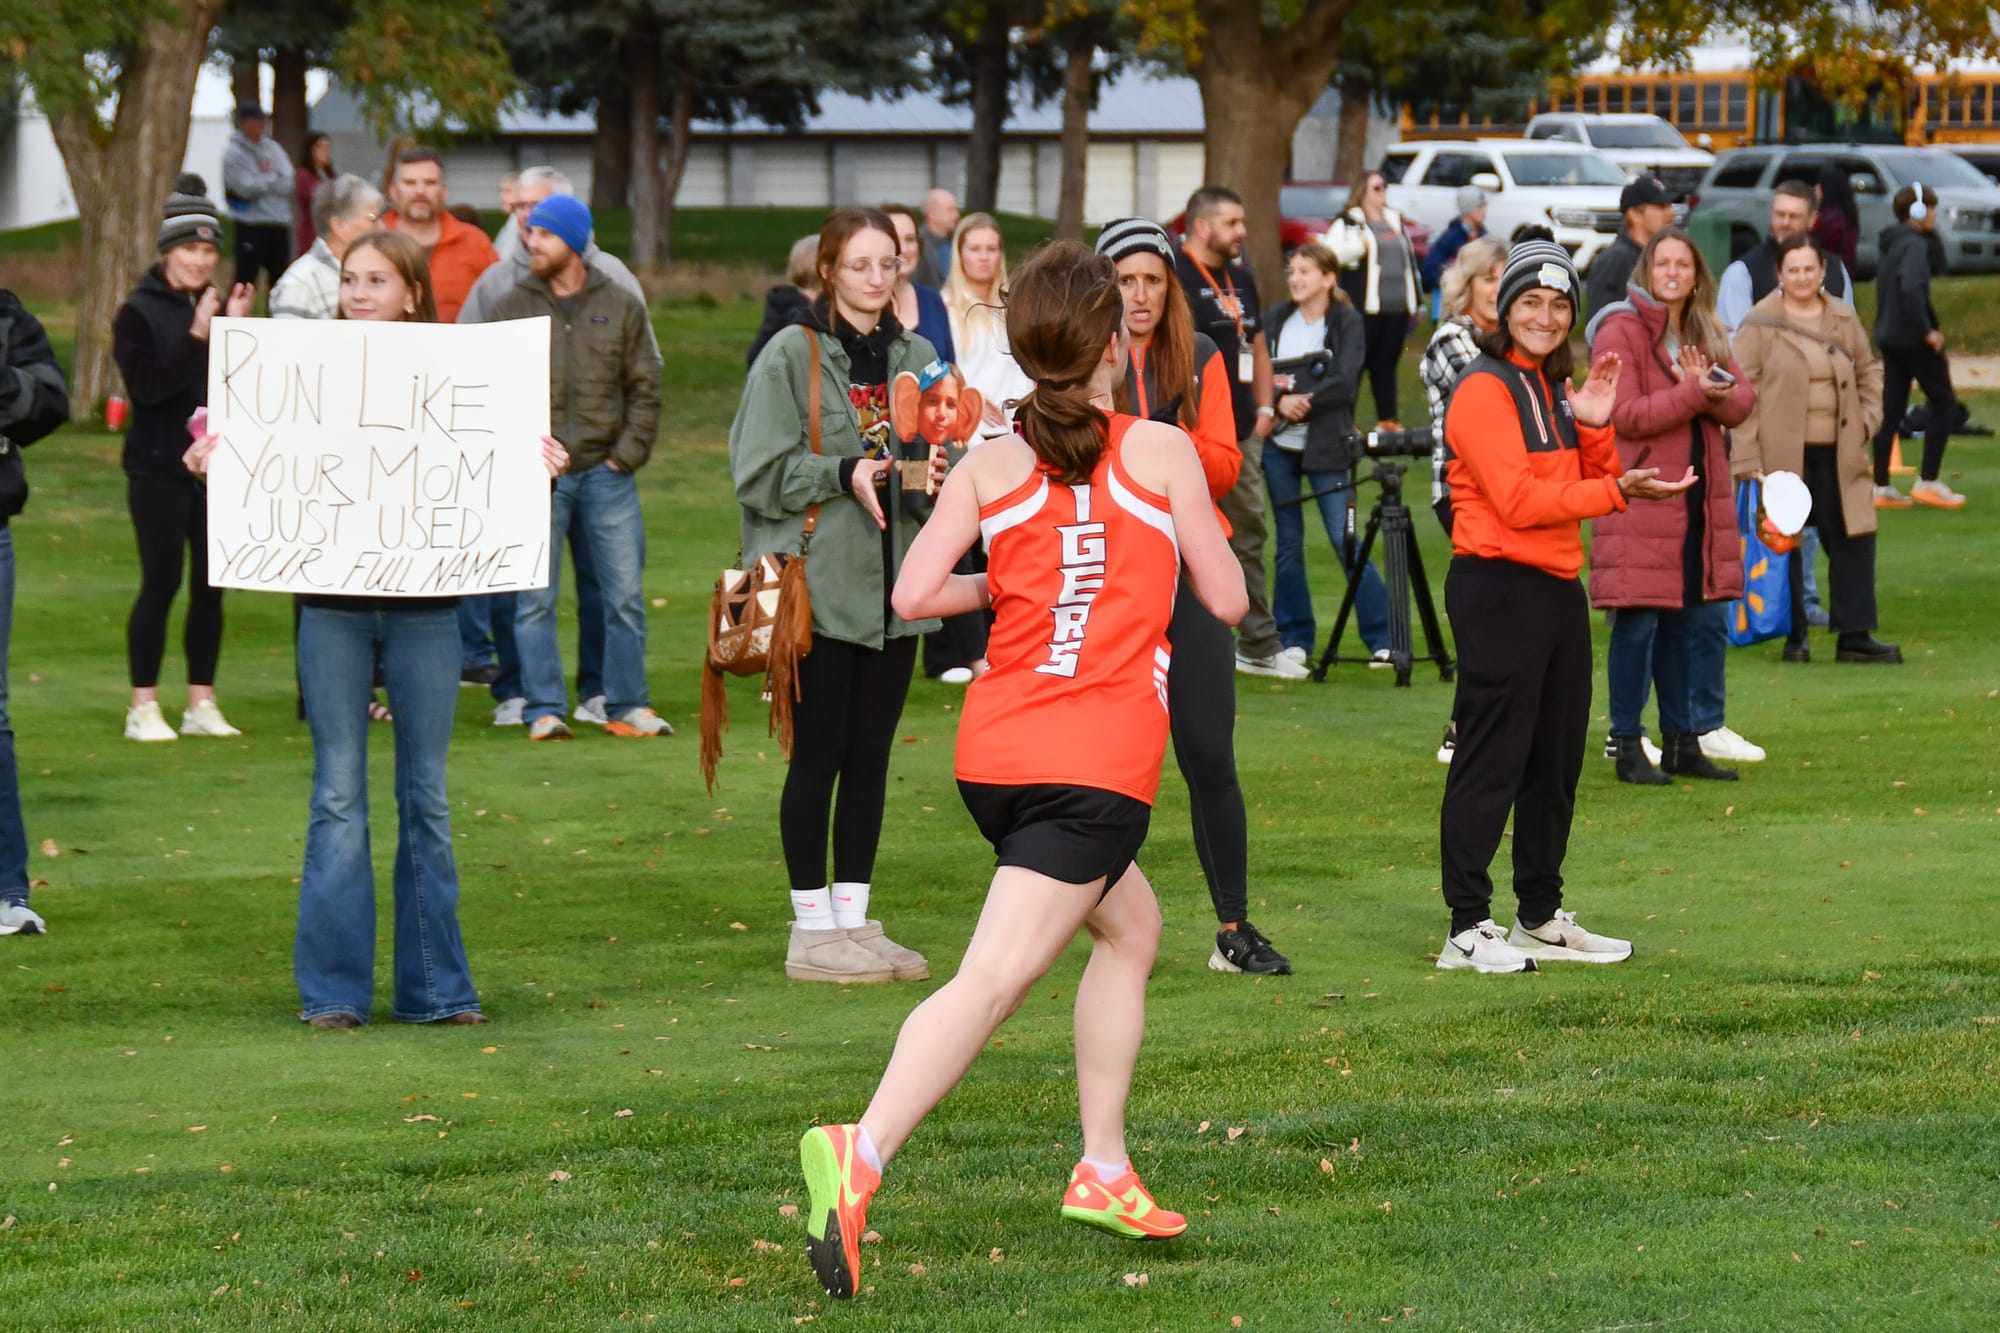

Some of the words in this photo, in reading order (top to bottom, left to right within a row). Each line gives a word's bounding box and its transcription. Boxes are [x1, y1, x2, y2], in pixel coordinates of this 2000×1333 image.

[221, 328, 324, 430] RUN
[223, 434, 355, 509] YOUR
[367, 443, 495, 509] MOM
[248, 496, 353, 545] JUST
[378, 503, 484, 550] USED
[217, 538, 334, 588] YOUR
[340, 551, 413, 592] FULL
[1033, 481, 1107, 678] IGERS
